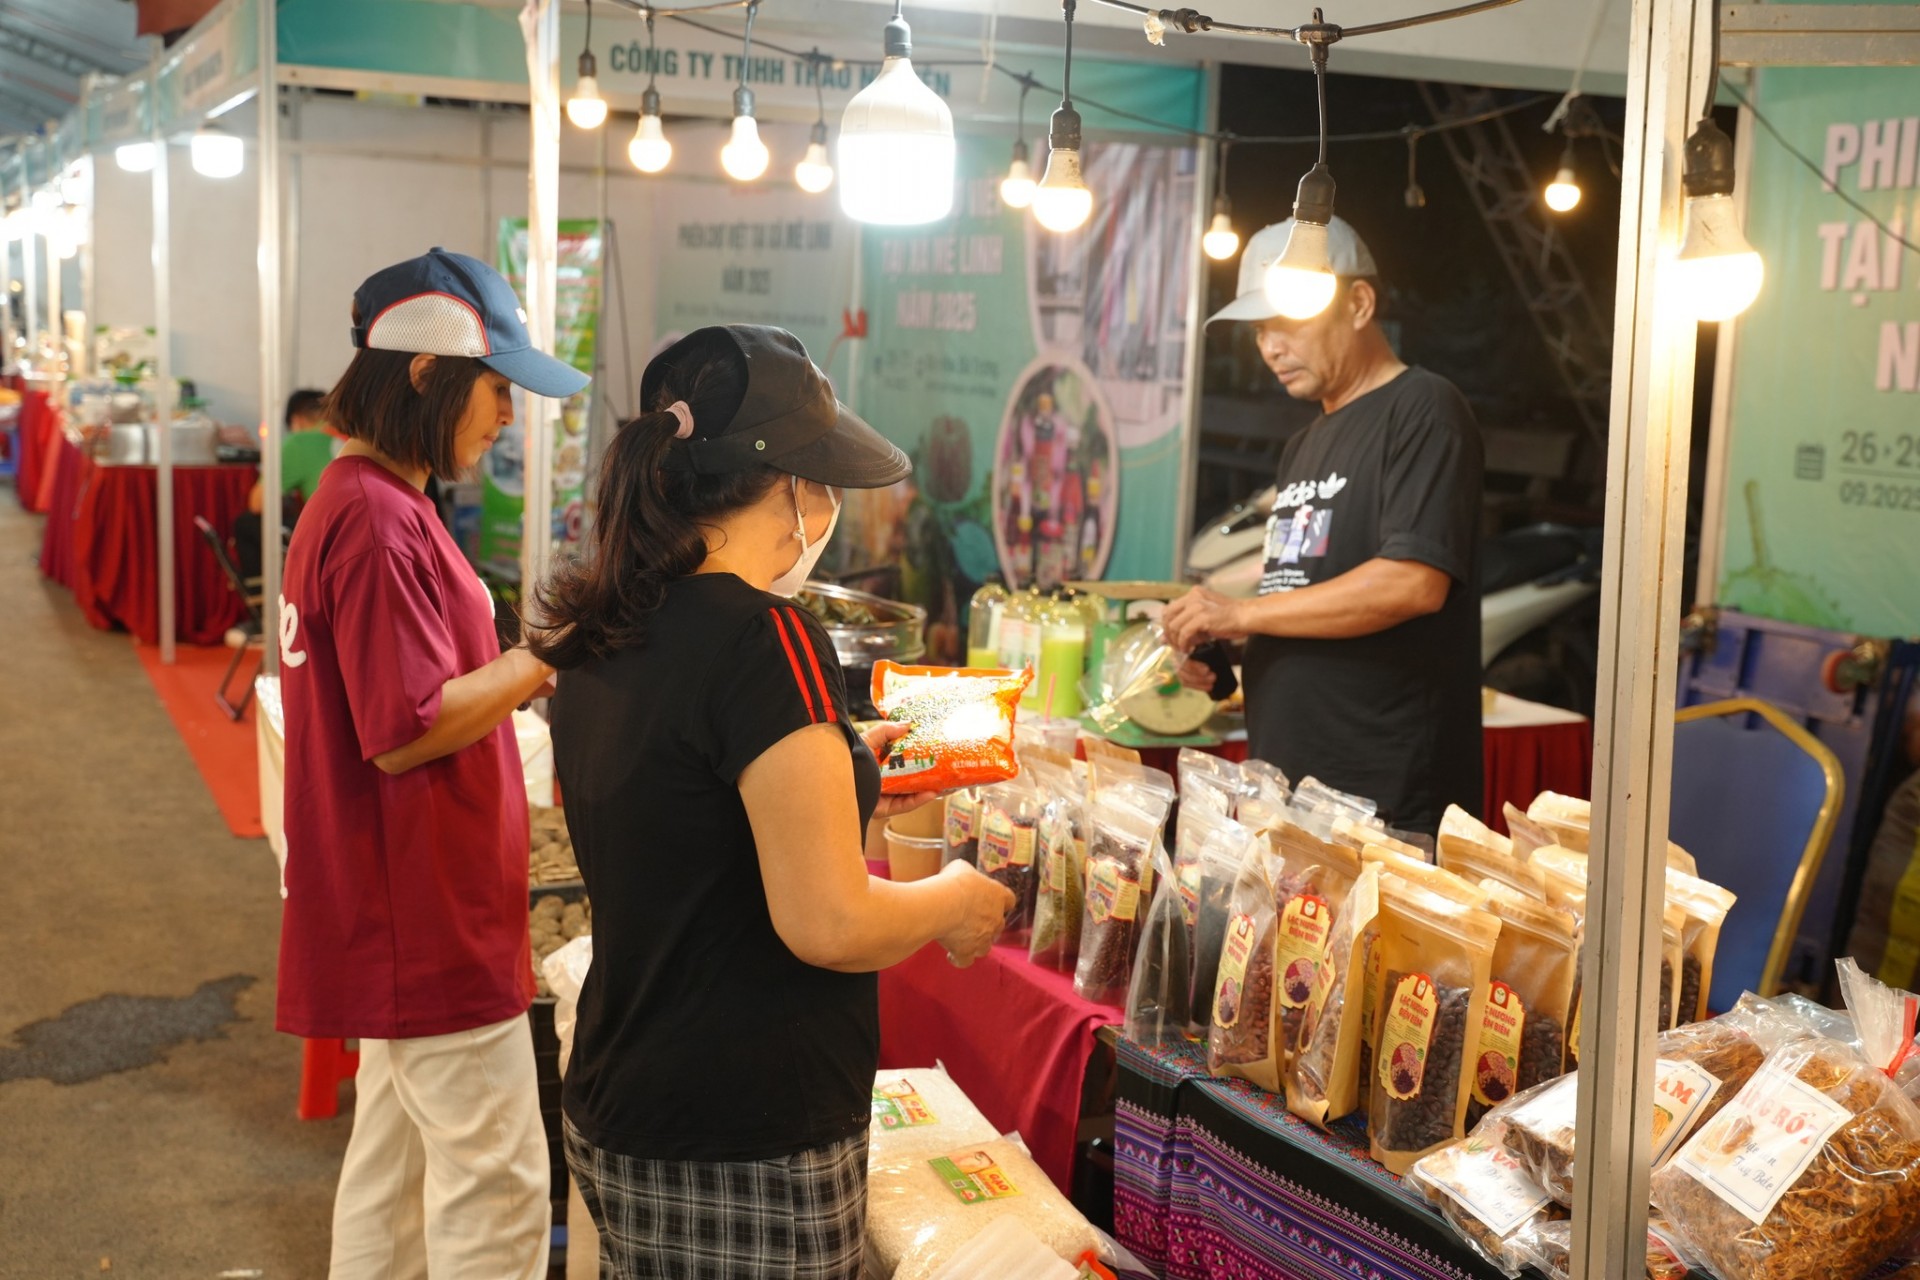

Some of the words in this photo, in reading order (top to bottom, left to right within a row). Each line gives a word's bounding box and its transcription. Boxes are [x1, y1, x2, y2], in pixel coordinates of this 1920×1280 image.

[610, 40, 678, 76] CÔNG
[687, 51, 715, 79] TY
[723, 54, 785, 85] TNHH
[1821, 117, 1920, 192] PHI
[1817, 218, 1907, 307] TẠI
[1875, 319, 1920, 393] N
[1840, 428, 1878, 465] 26
